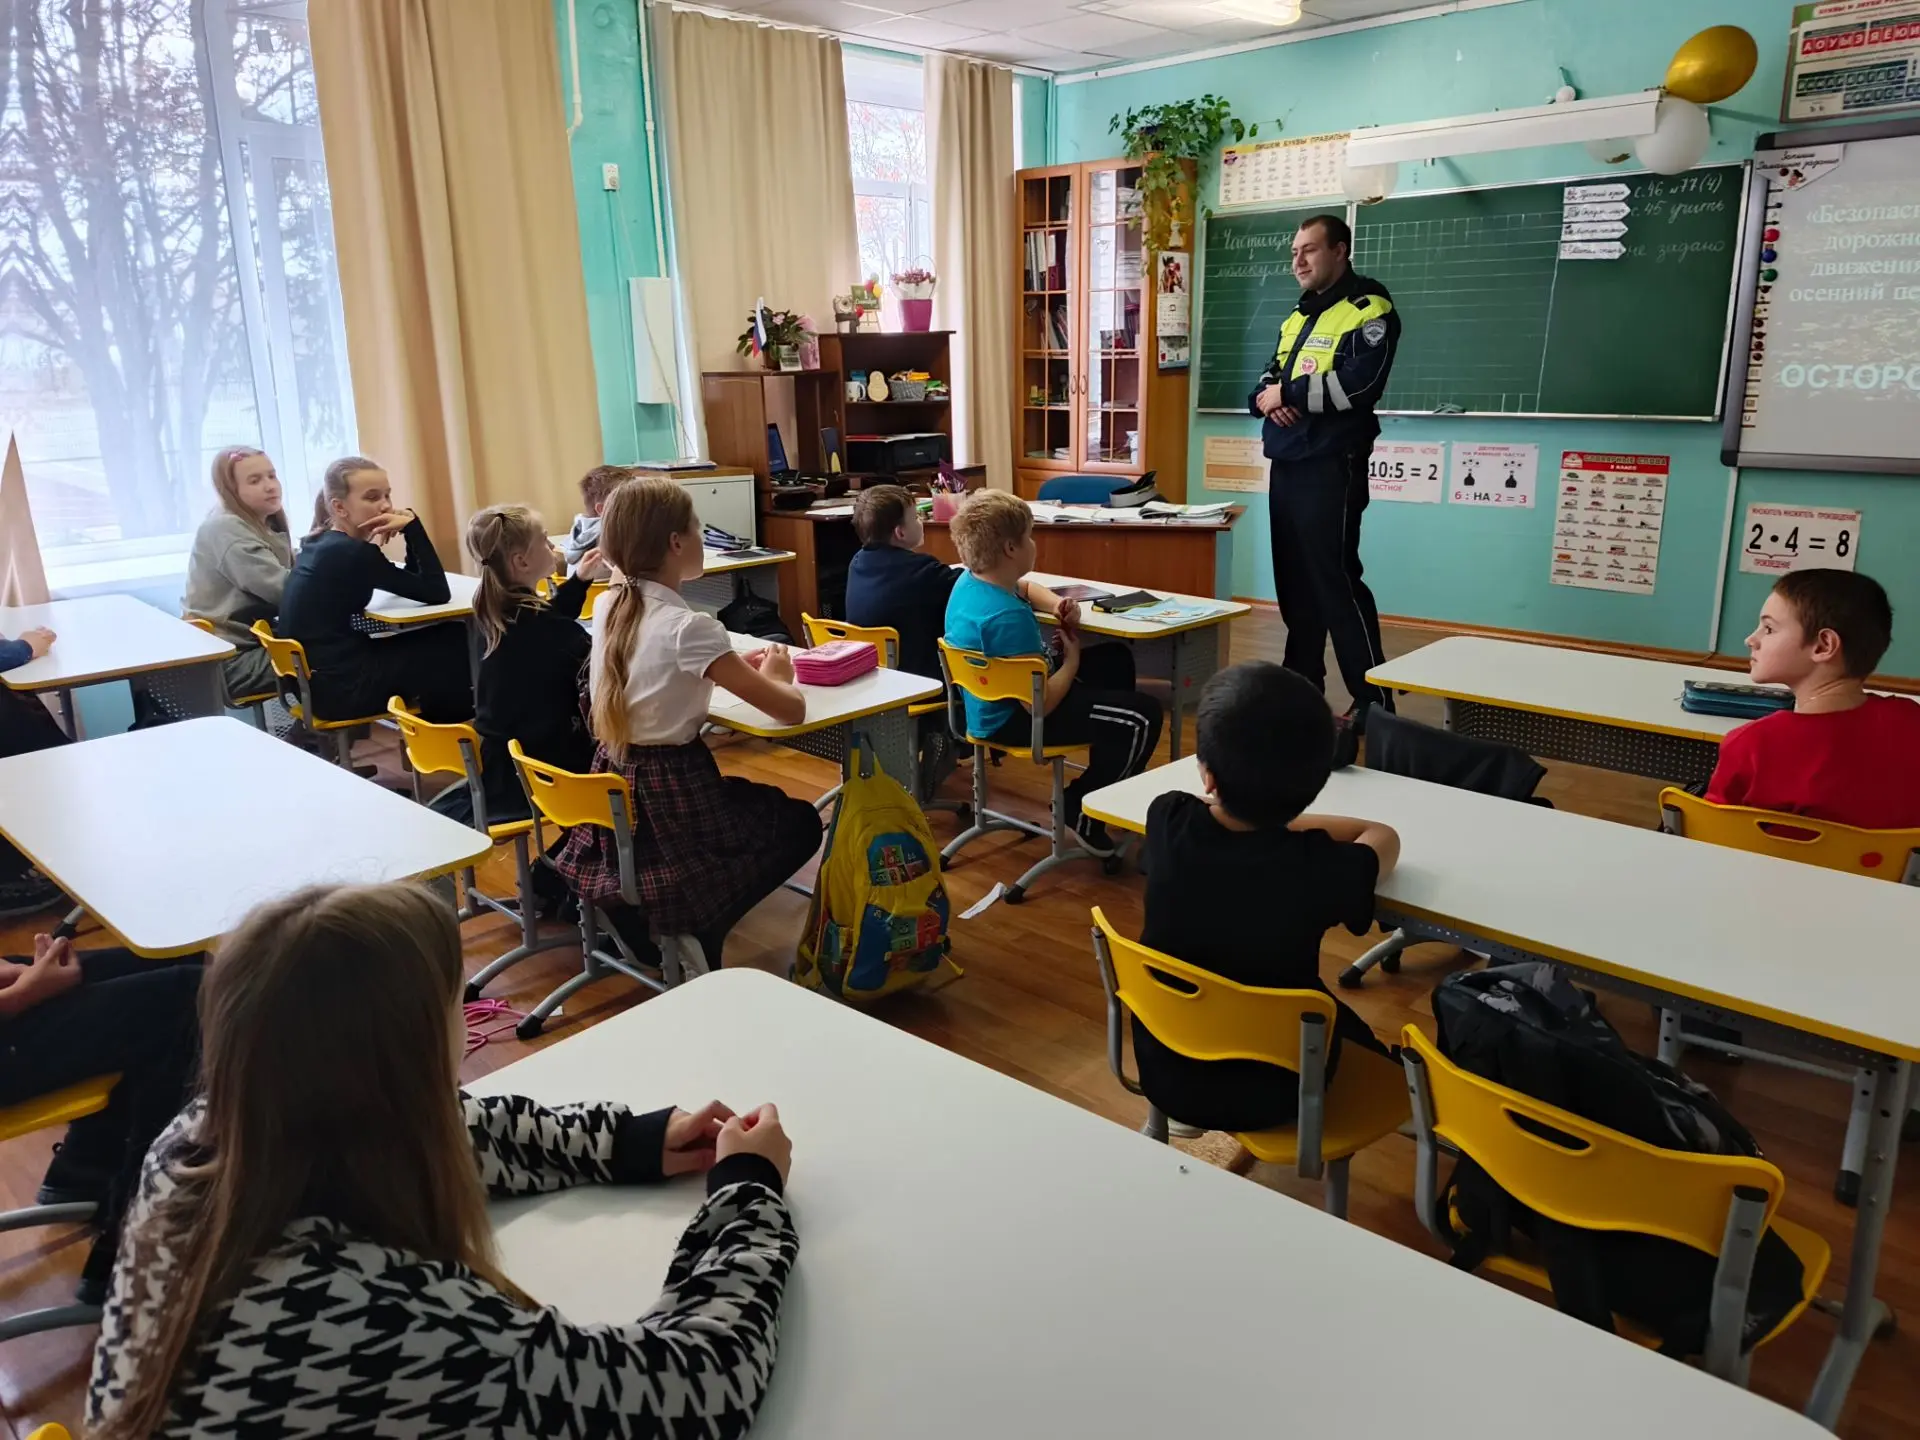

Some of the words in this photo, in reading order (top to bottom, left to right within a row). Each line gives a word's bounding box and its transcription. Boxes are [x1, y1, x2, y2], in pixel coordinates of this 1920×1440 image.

[1815, 40, 1826, 49] О
[1789, 281, 1884, 302] осенний
[1411, 467, 1422, 477] =
[1427, 464, 1438, 481] 2
[1454, 490, 1462, 500] 6
[1473, 492, 1490, 501] НА
[1494, 493, 1502, 503] 2
[1519, 494, 1527, 504] 3
[1749, 523, 1763, 550] 2
[1785, 526, 1799, 553] 4
[1808, 537, 1826, 550] =
[1836, 529, 1850, 558] 8
